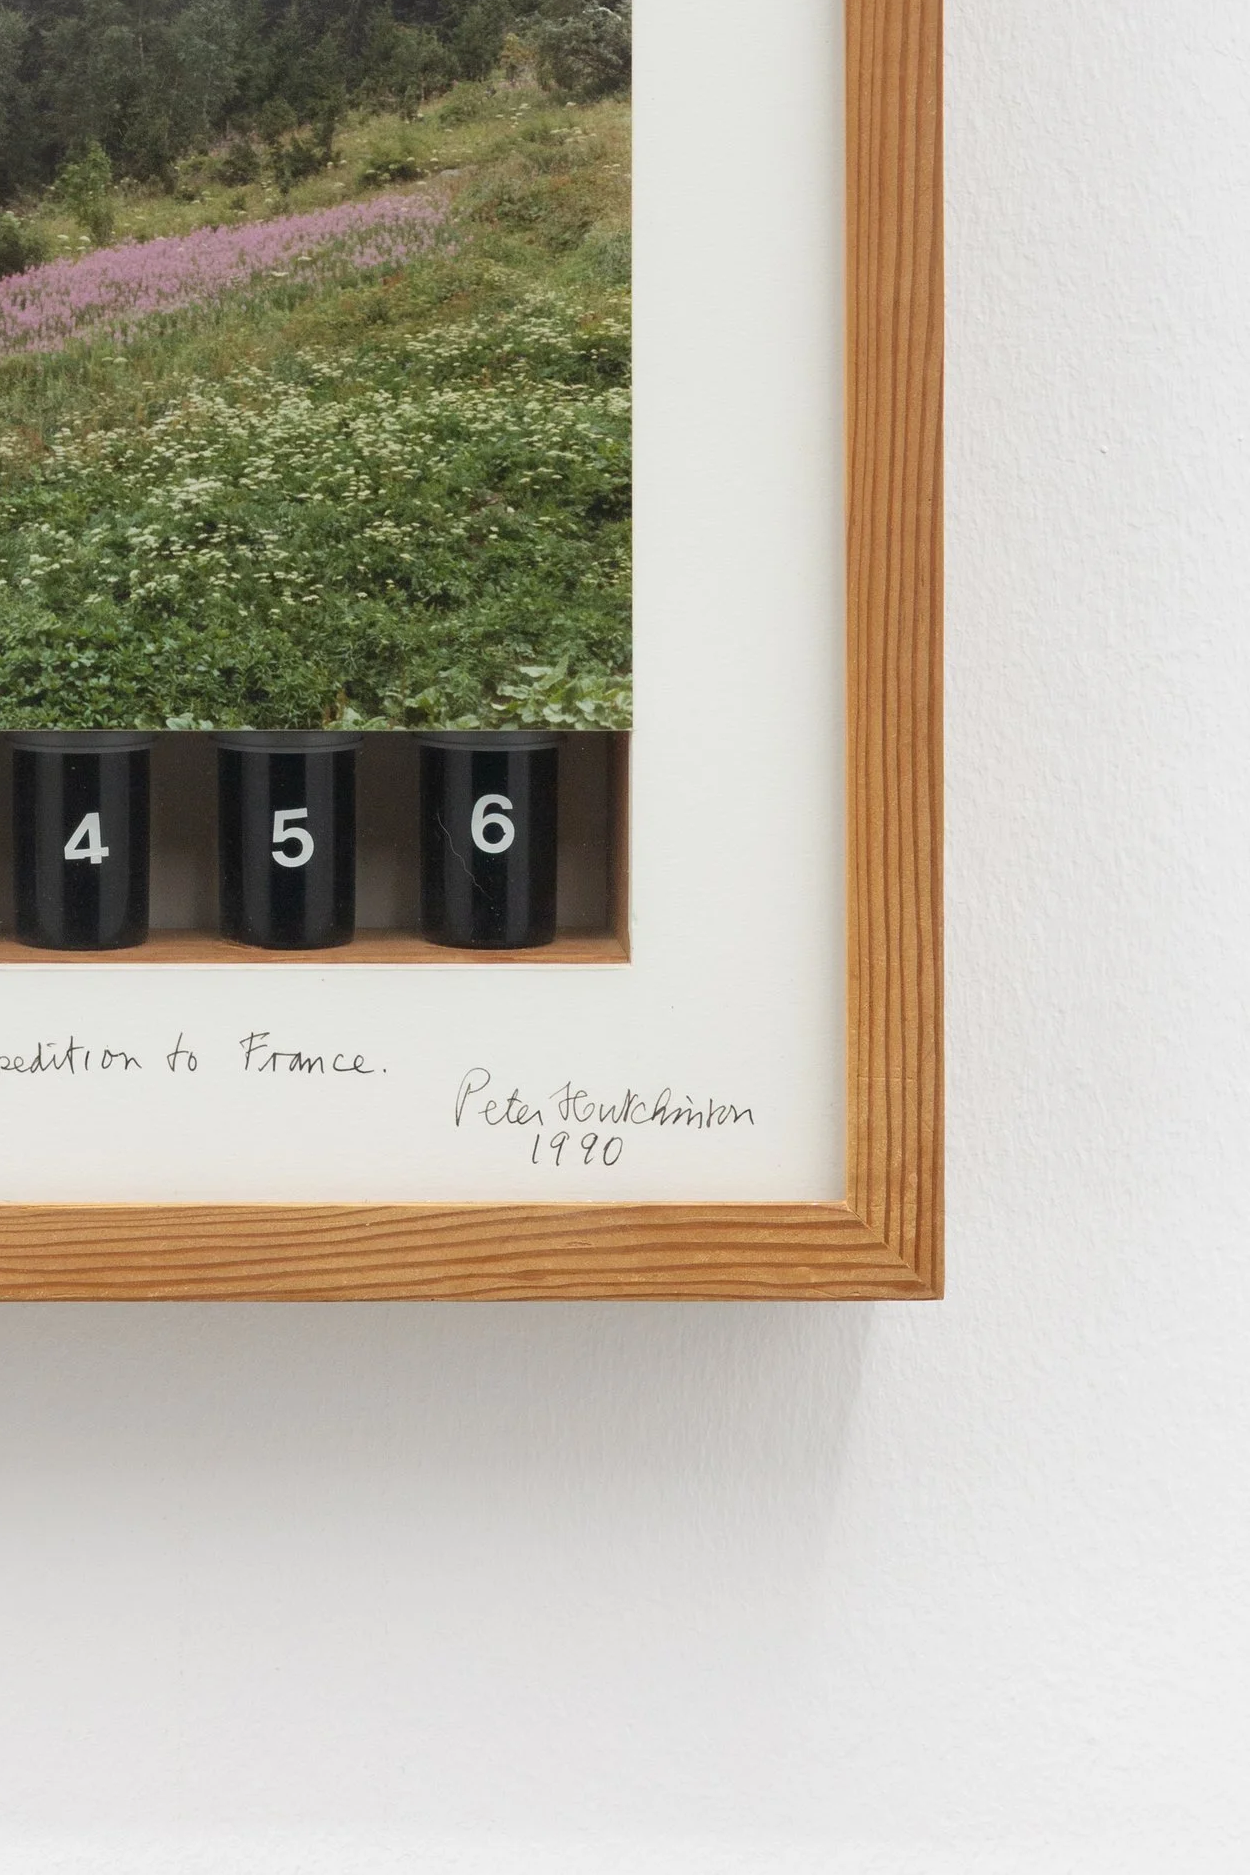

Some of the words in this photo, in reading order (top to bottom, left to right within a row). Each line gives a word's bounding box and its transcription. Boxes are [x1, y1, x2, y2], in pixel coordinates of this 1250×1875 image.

[65, 813, 109, 863] 4
[272, 808, 314, 867] 5
[472, 795, 514, 853] 6
[167, 1032, 197, 1072] to
[239, 1032, 386, 1074] France.
[456, 1068, 543, 1127] Peter
[532, 1131, 623, 1166] 1990
